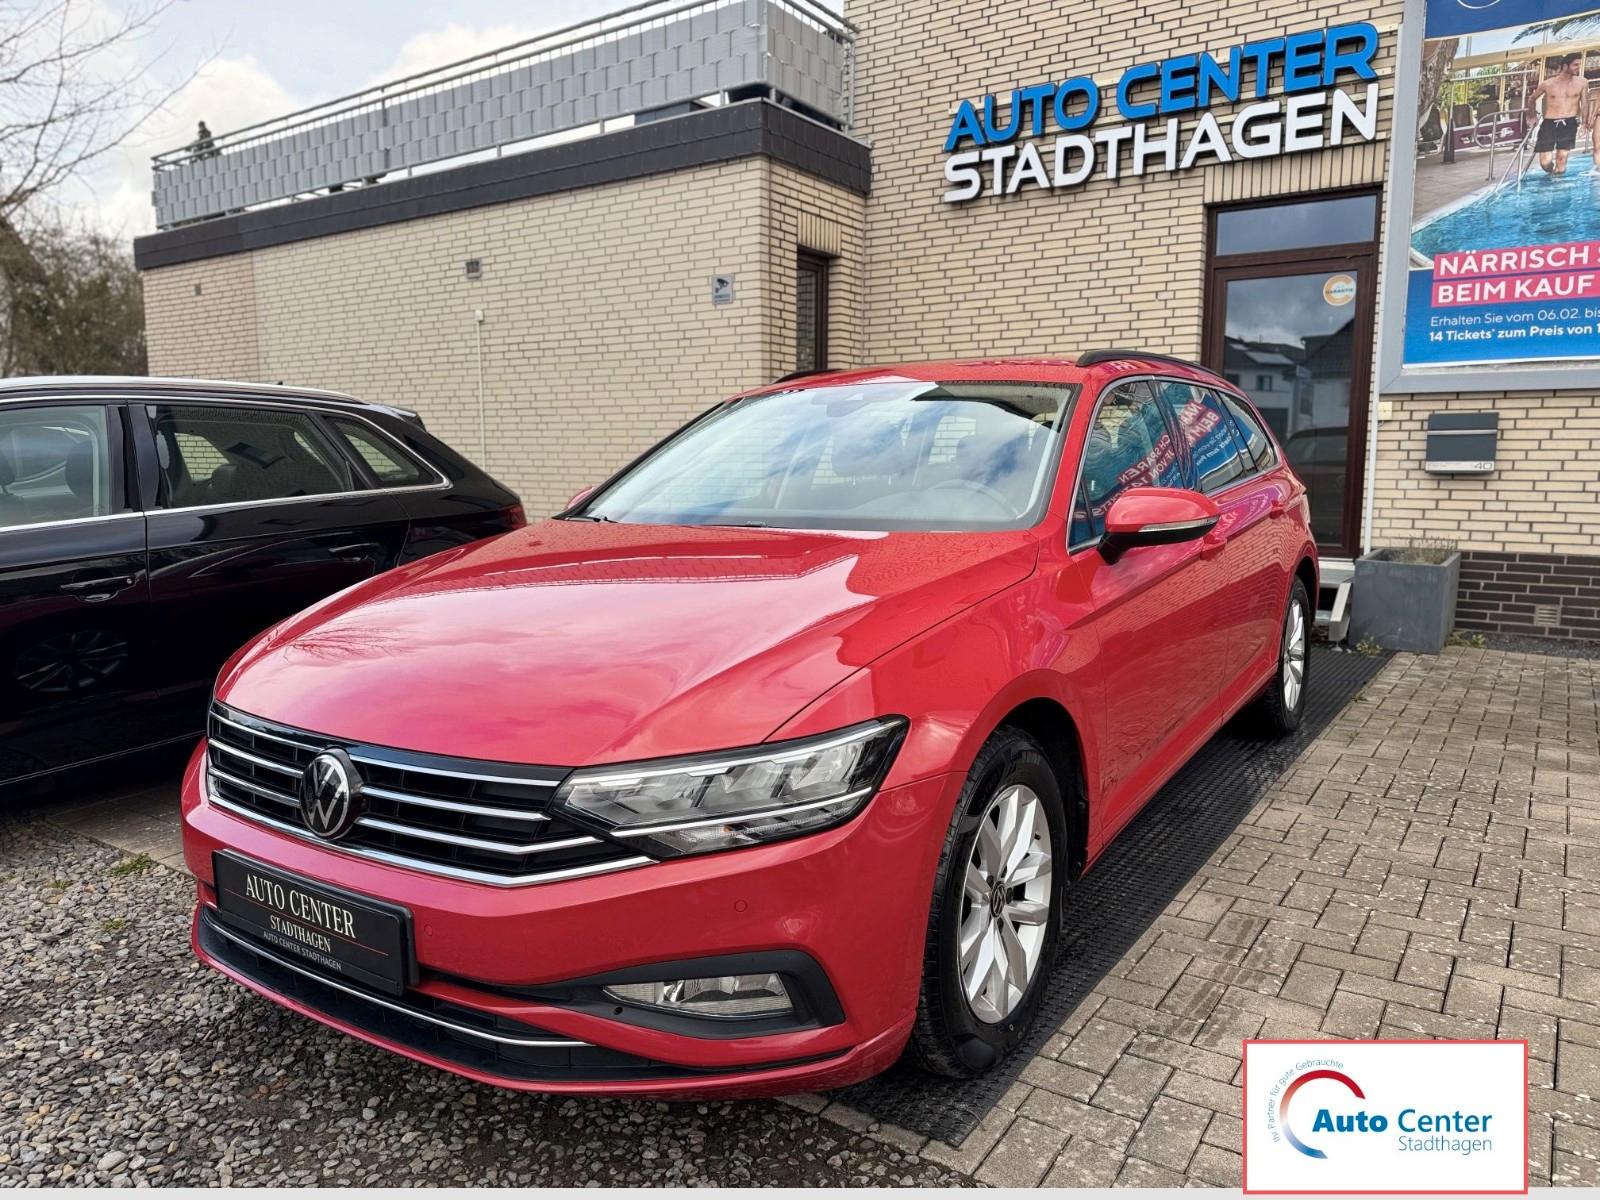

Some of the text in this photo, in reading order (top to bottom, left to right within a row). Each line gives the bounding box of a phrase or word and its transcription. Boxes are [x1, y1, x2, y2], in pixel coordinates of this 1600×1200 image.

[944, 22, 1379, 152] AUTO CENTER
[944, 83, 1379, 202] STADTHAGEN
[1440, 245, 1590, 276] NÄRRISCH
[1438, 275, 1595, 304] BEIM KAUF
[1429, 331, 1443, 342] 14
[1497, 328, 1526, 338] zum
[1530, 324, 1564, 337] Preis
[1567, 325, 1593, 335] von
[1430, 315, 1481, 327] Erhalten
[1484, 313, 1504, 324] Sie
[1506, 312, 1534, 322] vom
[1537, 308, 1581, 320] 06.02.
[246, 874, 356, 939] AUTO CENTER
[263, 930, 342, 971] AUTO CENTER STADTHAGEN
[269, 915, 332, 953] STADTHAGEN
